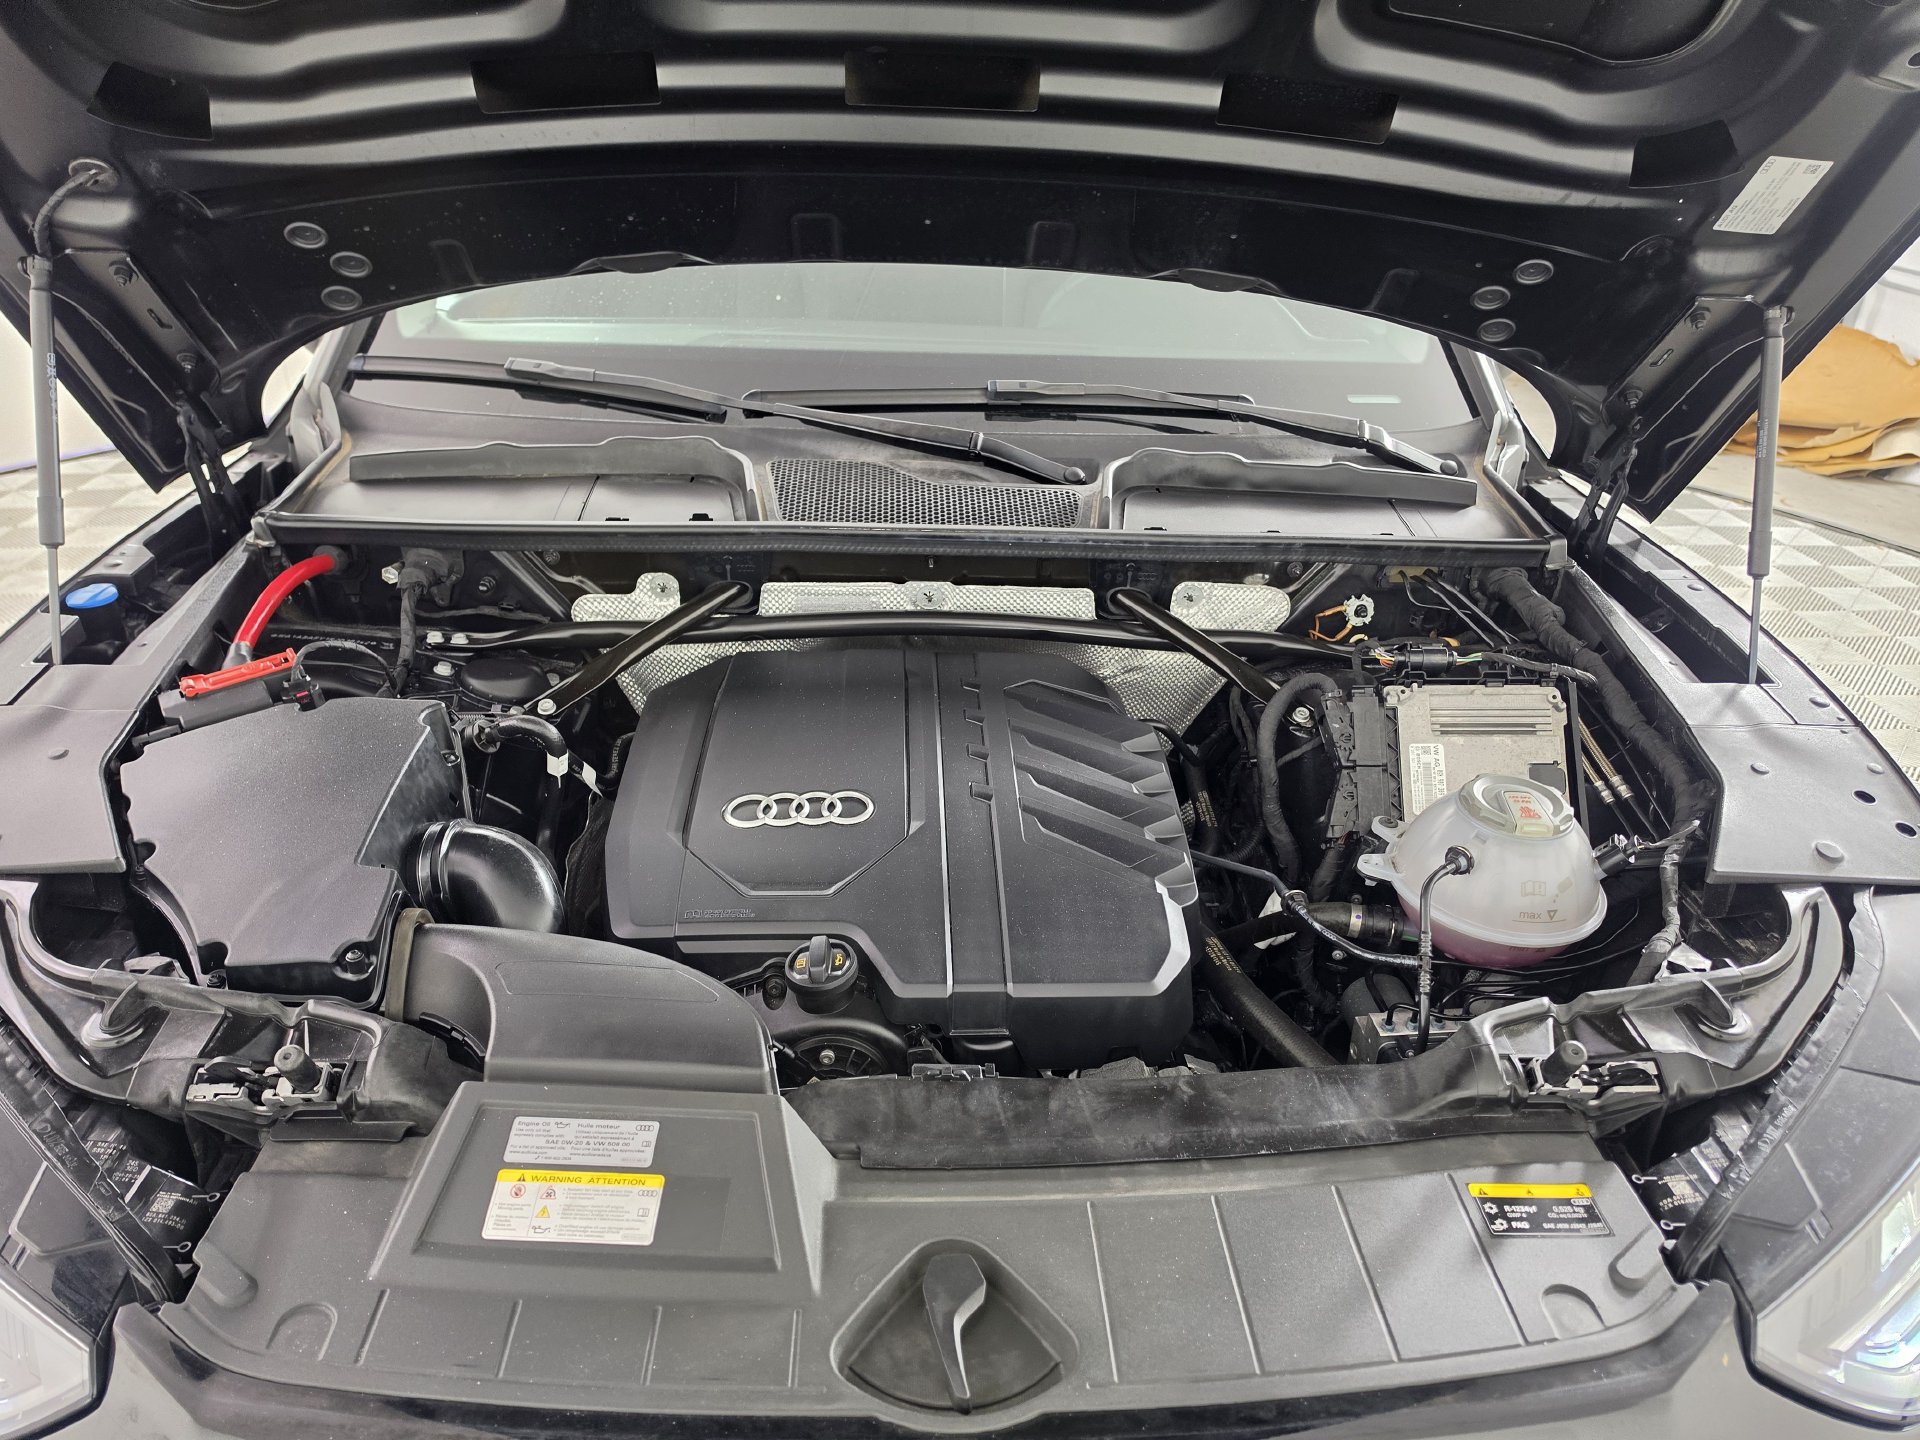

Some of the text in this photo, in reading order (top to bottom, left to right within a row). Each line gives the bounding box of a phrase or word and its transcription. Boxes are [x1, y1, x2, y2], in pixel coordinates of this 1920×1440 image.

[1433, 745, 1440, 757] VW
[1518, 910, 1542, 921] max
[517, 1120, 540, 1128] Engine
[530, 1174, 647, 1186] WARNING ATTENTION
[1504, 1205, 1537, 1213] R-1234yf
[1574, 1205, 1585, 1214] kg
[1511, 1221, 1531, 1229] PAG
